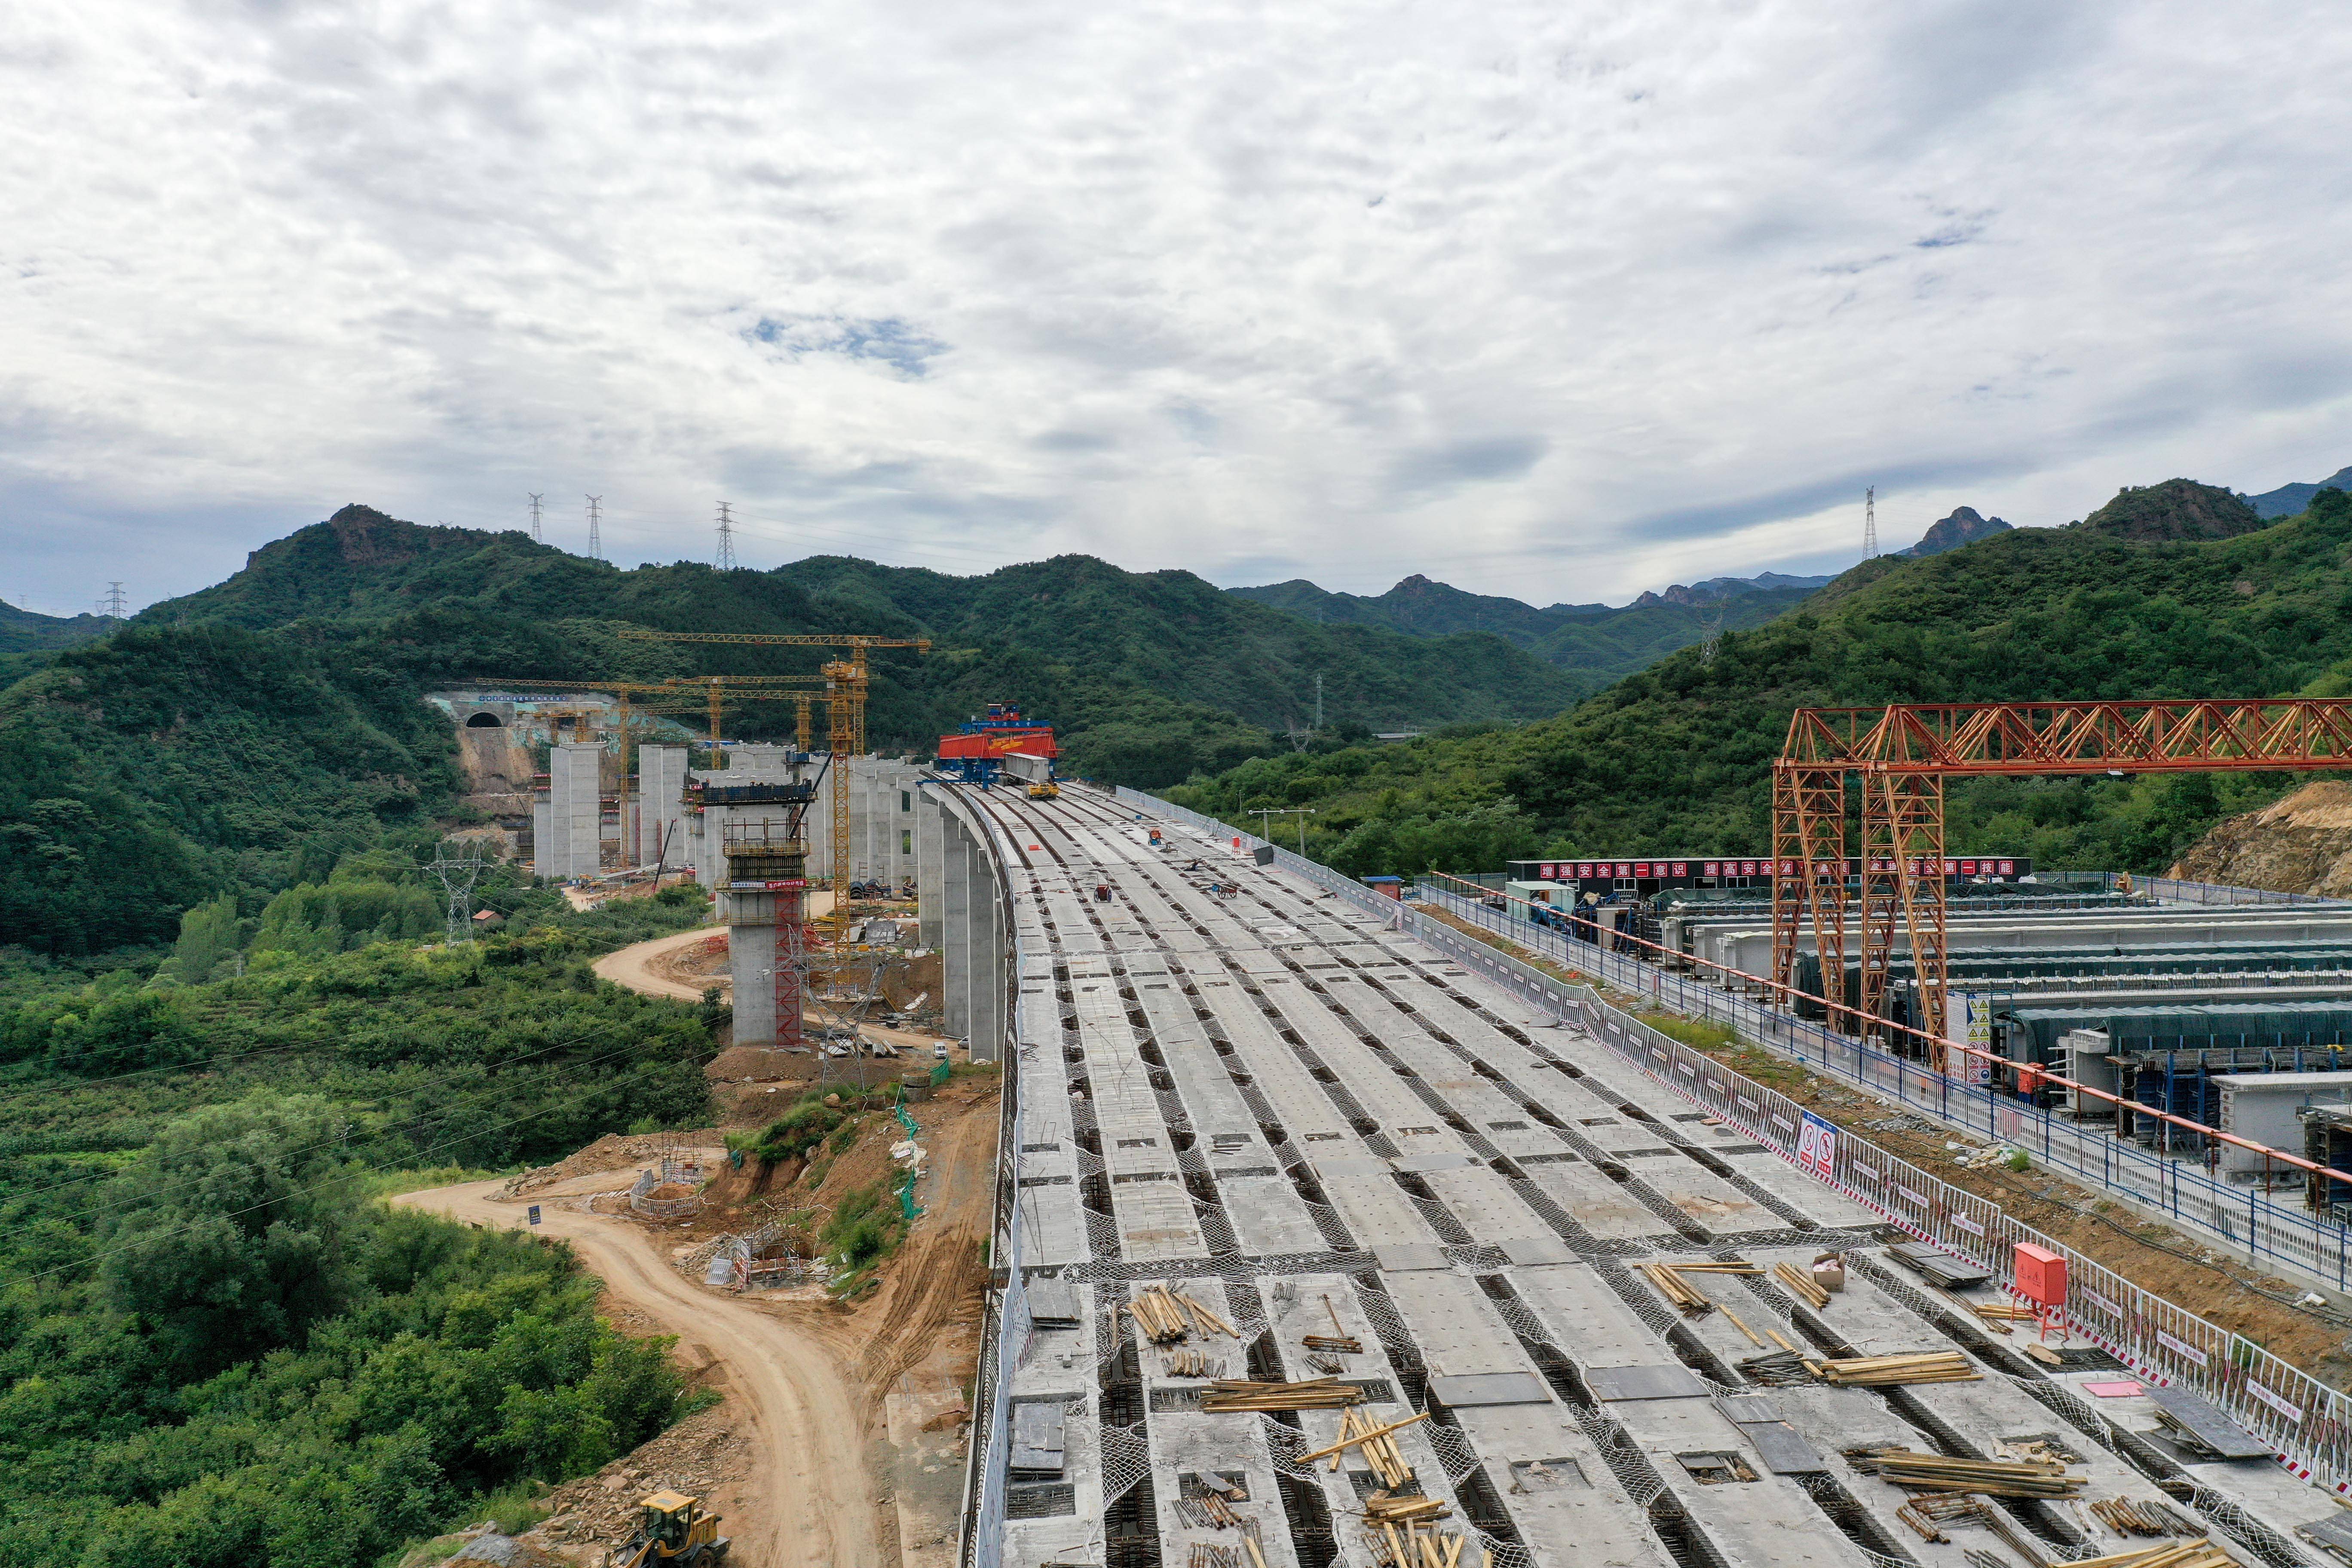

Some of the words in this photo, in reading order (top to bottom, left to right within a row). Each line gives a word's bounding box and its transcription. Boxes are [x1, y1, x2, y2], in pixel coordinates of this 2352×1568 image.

[1542, 864, 1685, 877] 增强安全第一意识
[1706, 862, 1848, 875] 提高安全第素
